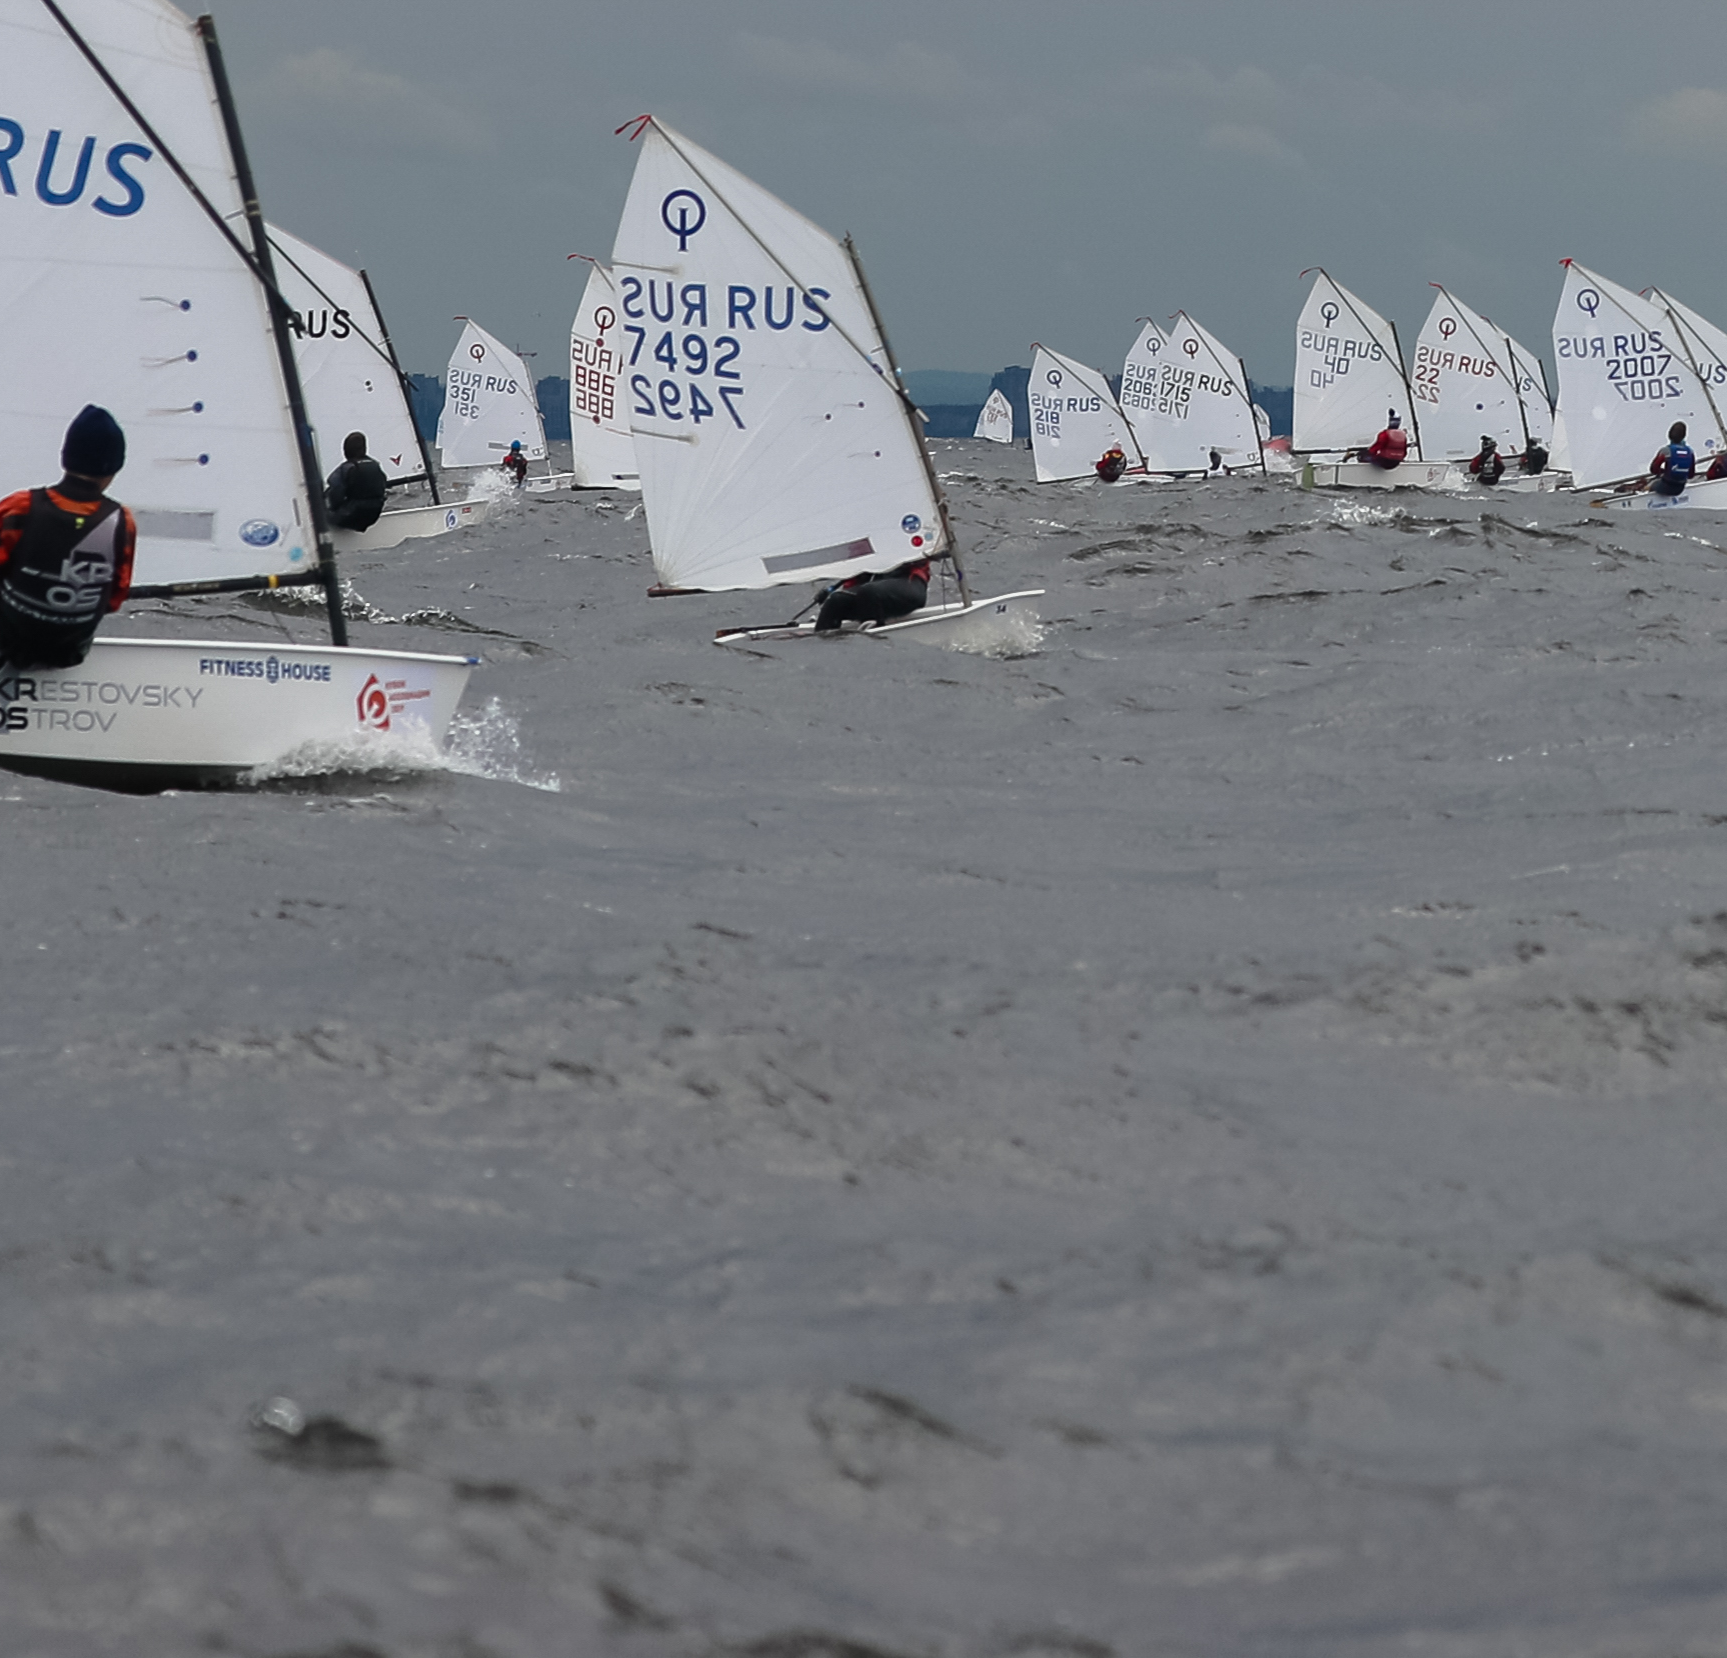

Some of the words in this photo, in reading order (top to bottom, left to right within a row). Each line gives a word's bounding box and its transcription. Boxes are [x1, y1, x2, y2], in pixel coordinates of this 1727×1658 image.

[727, 285, 831, 332] RUS
[623, 324, 741, 380] 7492
[1343, 341, 1383, 362] RUS
[1613, 331, 1664, 357] RUS
[1324, 355, 1350, 375] 40
[1415, 365, 1441, 385] 22
[1458, 355, 1496, 377] RUS
[1606, 354, 1672, 381] 2007
[450, 385, 475, 403] 351
[486, 376, 518, 395] RUS
[1160, 381, 1192, 402] 1715
[1197, 374, 1233, 397] RUS
[1066, 397, 1101, 413] RUS
[1034, 409, 1060, 424] 218
[200, 659, 263, 678] FITNESS
[281, 664, 331, 681] HOUSE
